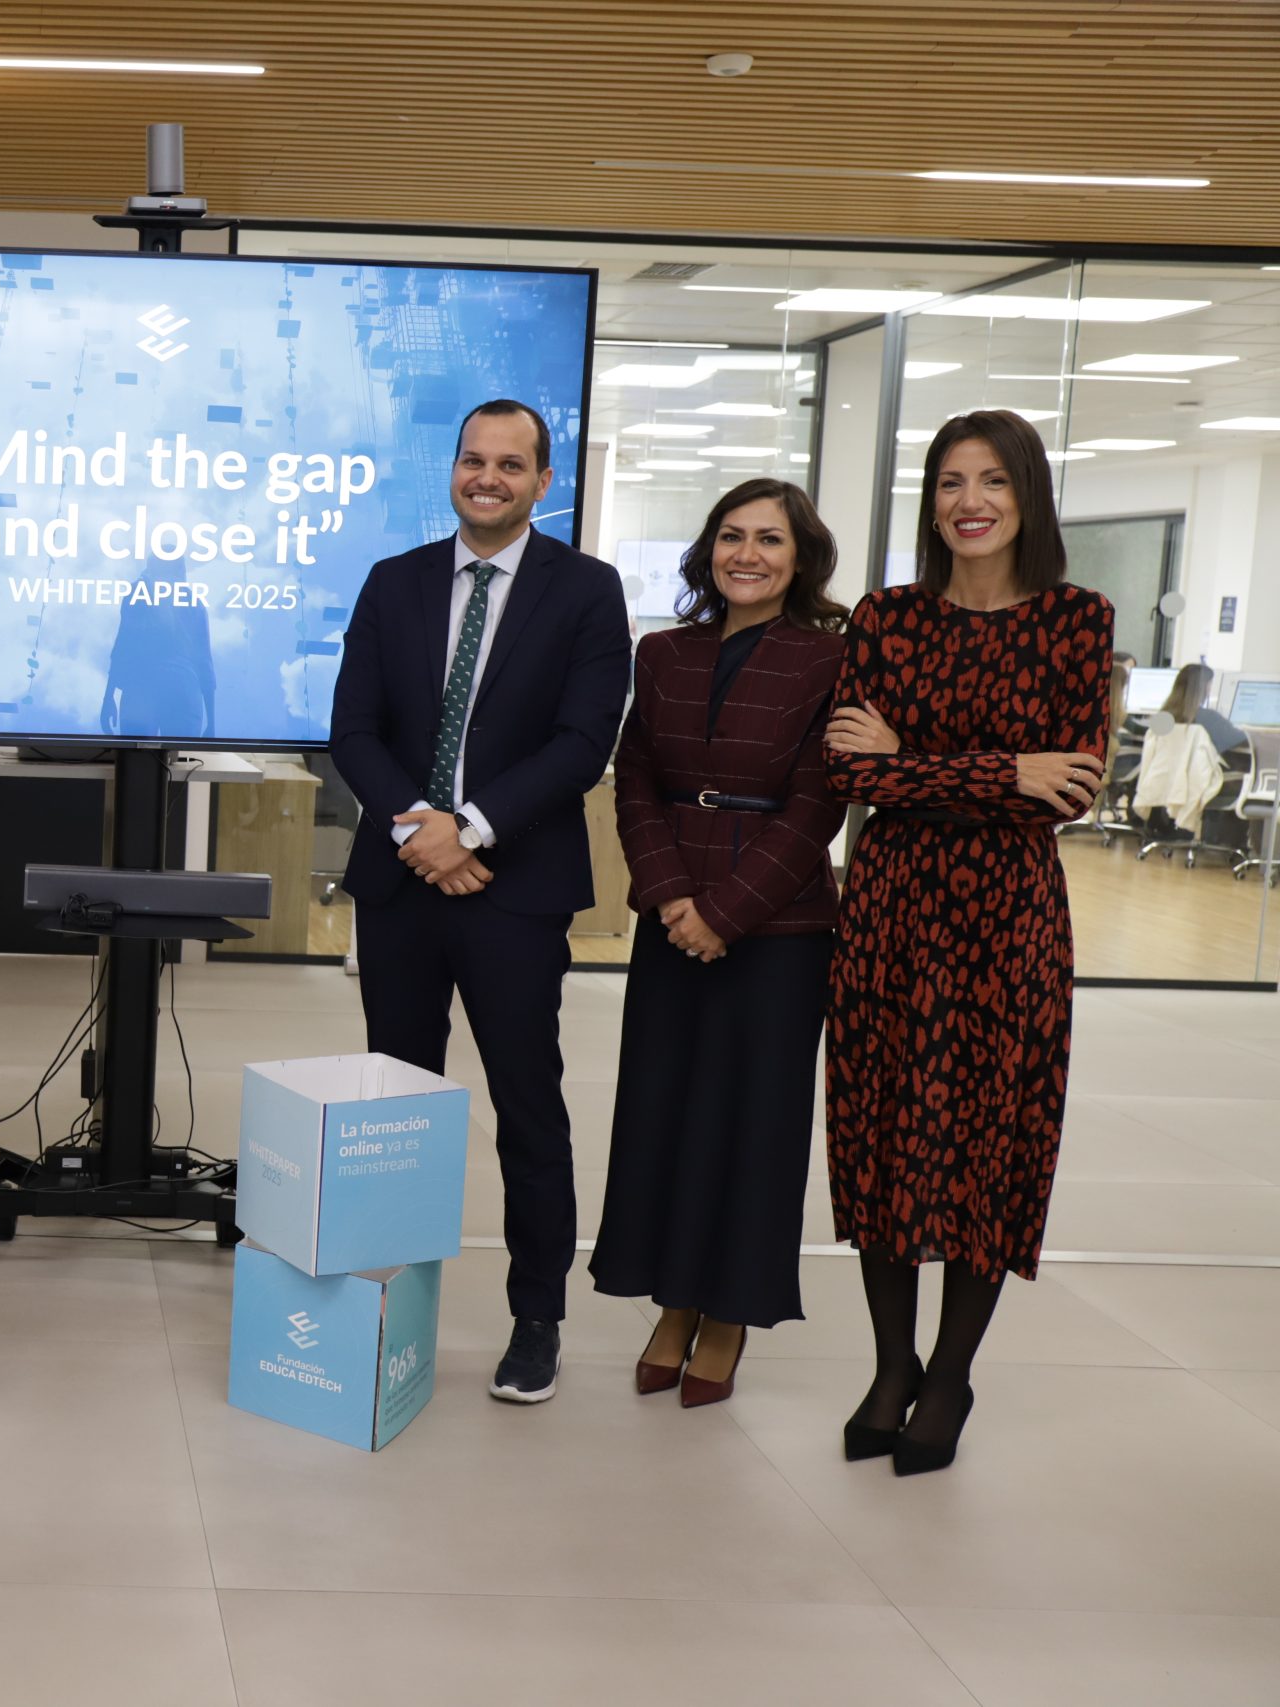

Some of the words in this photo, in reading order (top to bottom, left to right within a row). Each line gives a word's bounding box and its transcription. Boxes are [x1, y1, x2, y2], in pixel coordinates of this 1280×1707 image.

[146, 433, 248, 491] the
[265, 452, 376, 506] gap
[99, 505, 256, 563] close
[276, 509, 344, 566] it”
[8, 576, 210, 608] WHITEPAPER
[225, 583, 298, 610] 2025
[340, 1122, 357, 1138] La
[361, 1116, 431, 1136] formación
[248, 1138, 301, 1180] WHITEPAPER
[339, 1141, 384, 1157] online
[387, 1141, 402, 1156] ya
[405, 1139, 420, 1150] es
[262, 1163, 282, 1187] 2025
[338, 1157, 421, 1177] mainstream.
[260, 1360, 297, 1380] EDUCA
[298, 1371, 342, 1393] EDTECH
[277, 1353, 325, 1376] Fundación
[388, 1341, 417, 1390] 96%
